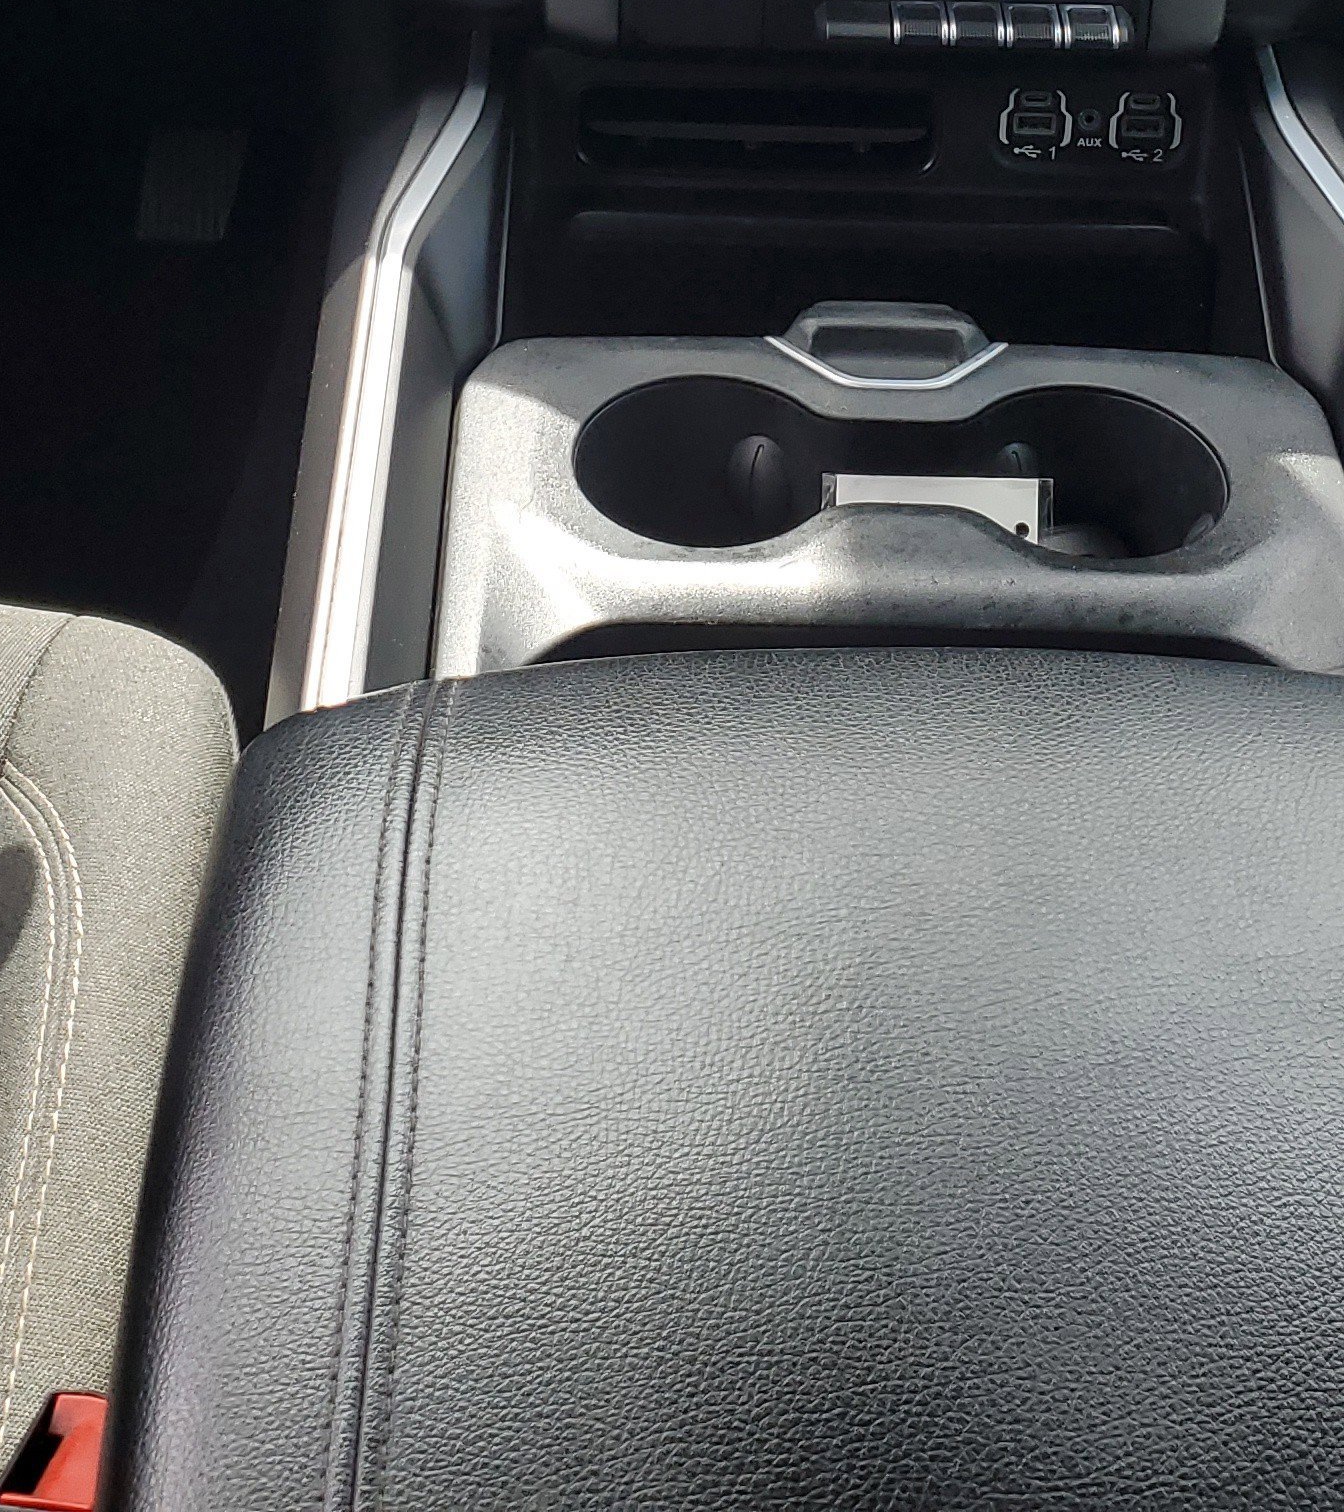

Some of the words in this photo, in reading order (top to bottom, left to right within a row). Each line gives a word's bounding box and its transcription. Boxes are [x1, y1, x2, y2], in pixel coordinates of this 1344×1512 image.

[1077, 137, 1102, 147] AUX
[1049, 146, 1056, 160] 1
[1153, 149, 1163, 162] 2
